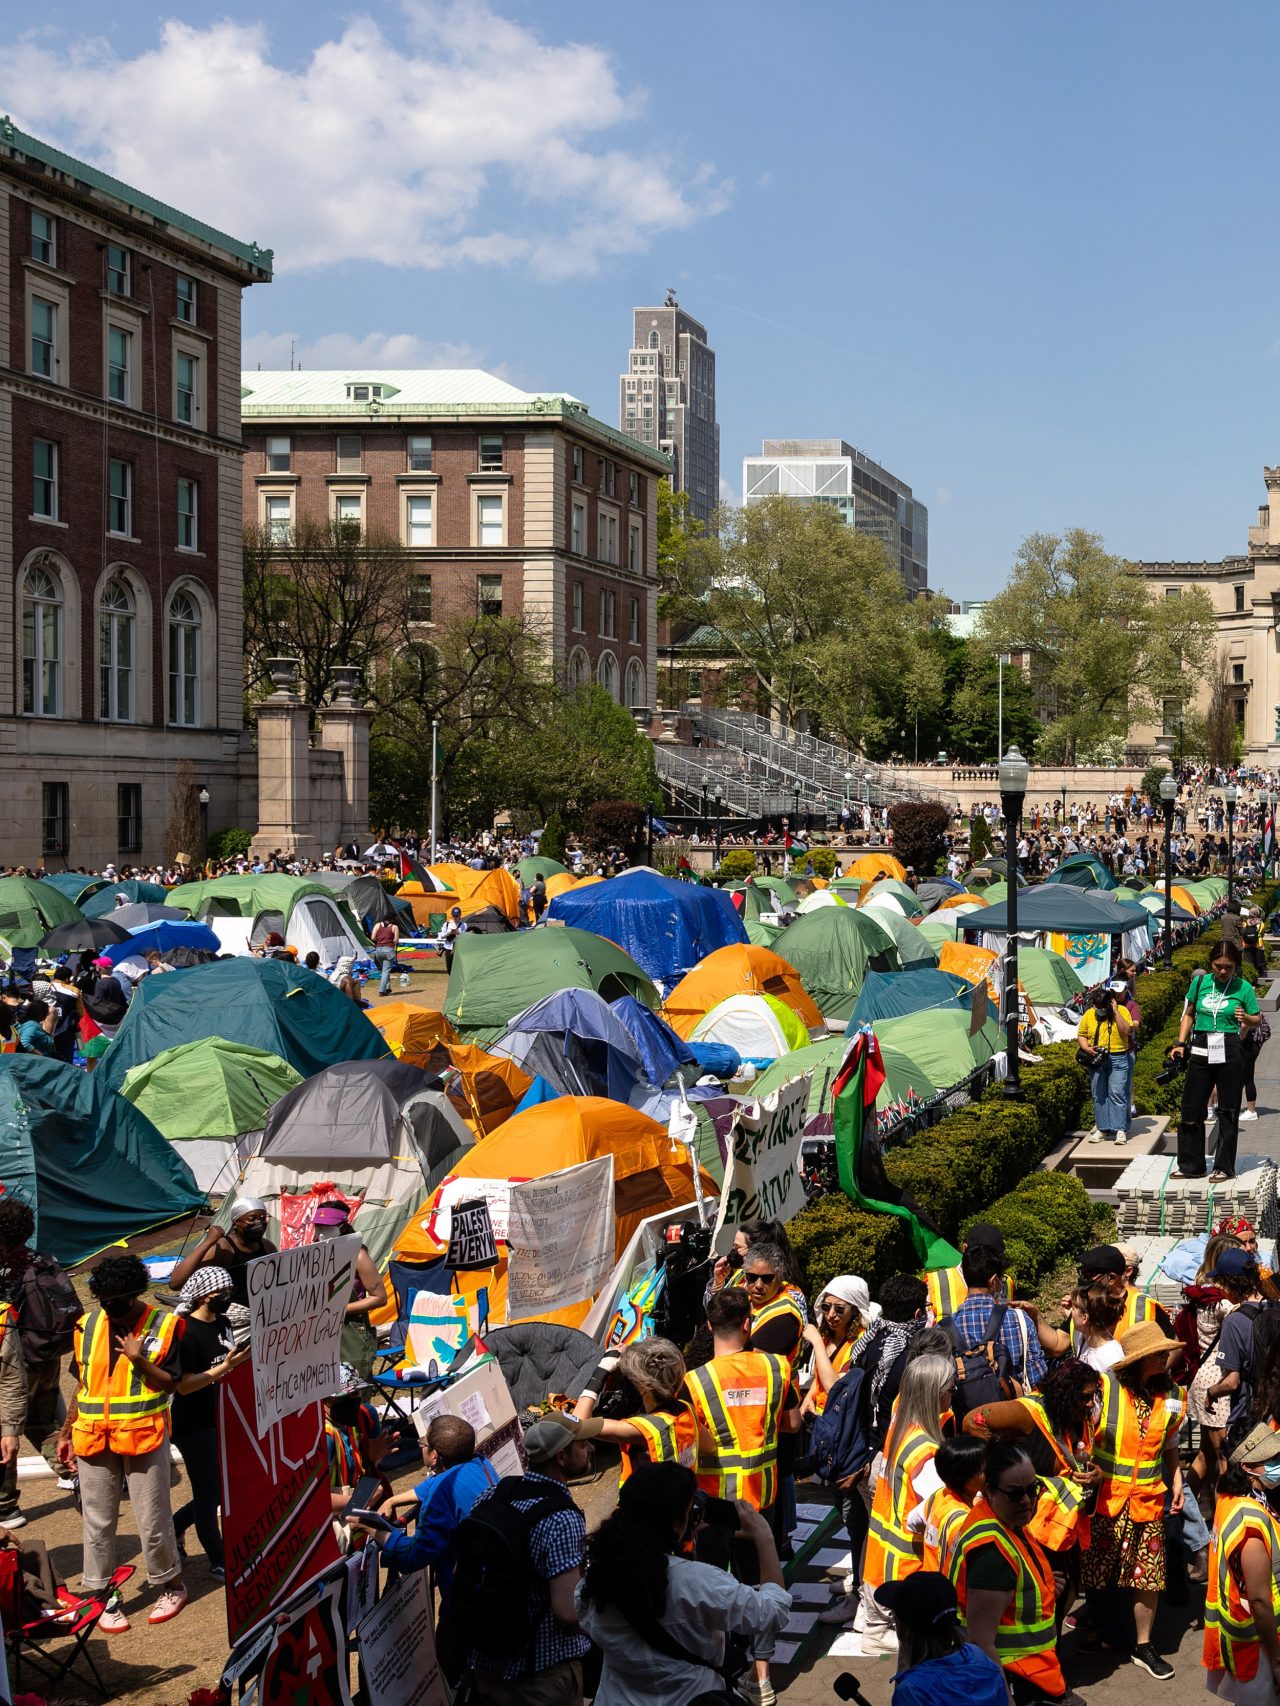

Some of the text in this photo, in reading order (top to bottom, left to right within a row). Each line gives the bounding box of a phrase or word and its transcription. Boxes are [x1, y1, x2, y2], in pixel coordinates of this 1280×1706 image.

[250, 1244, 335, 1296] COLUMBIA
[254, 1281, 325, 1331] ALUMNI
[229, 1441, 325, 1572] JUSTIFICATION
[231, 1555, 267, 1600] FOR
[233, 1522, 310, 1625] GENOCIDE
